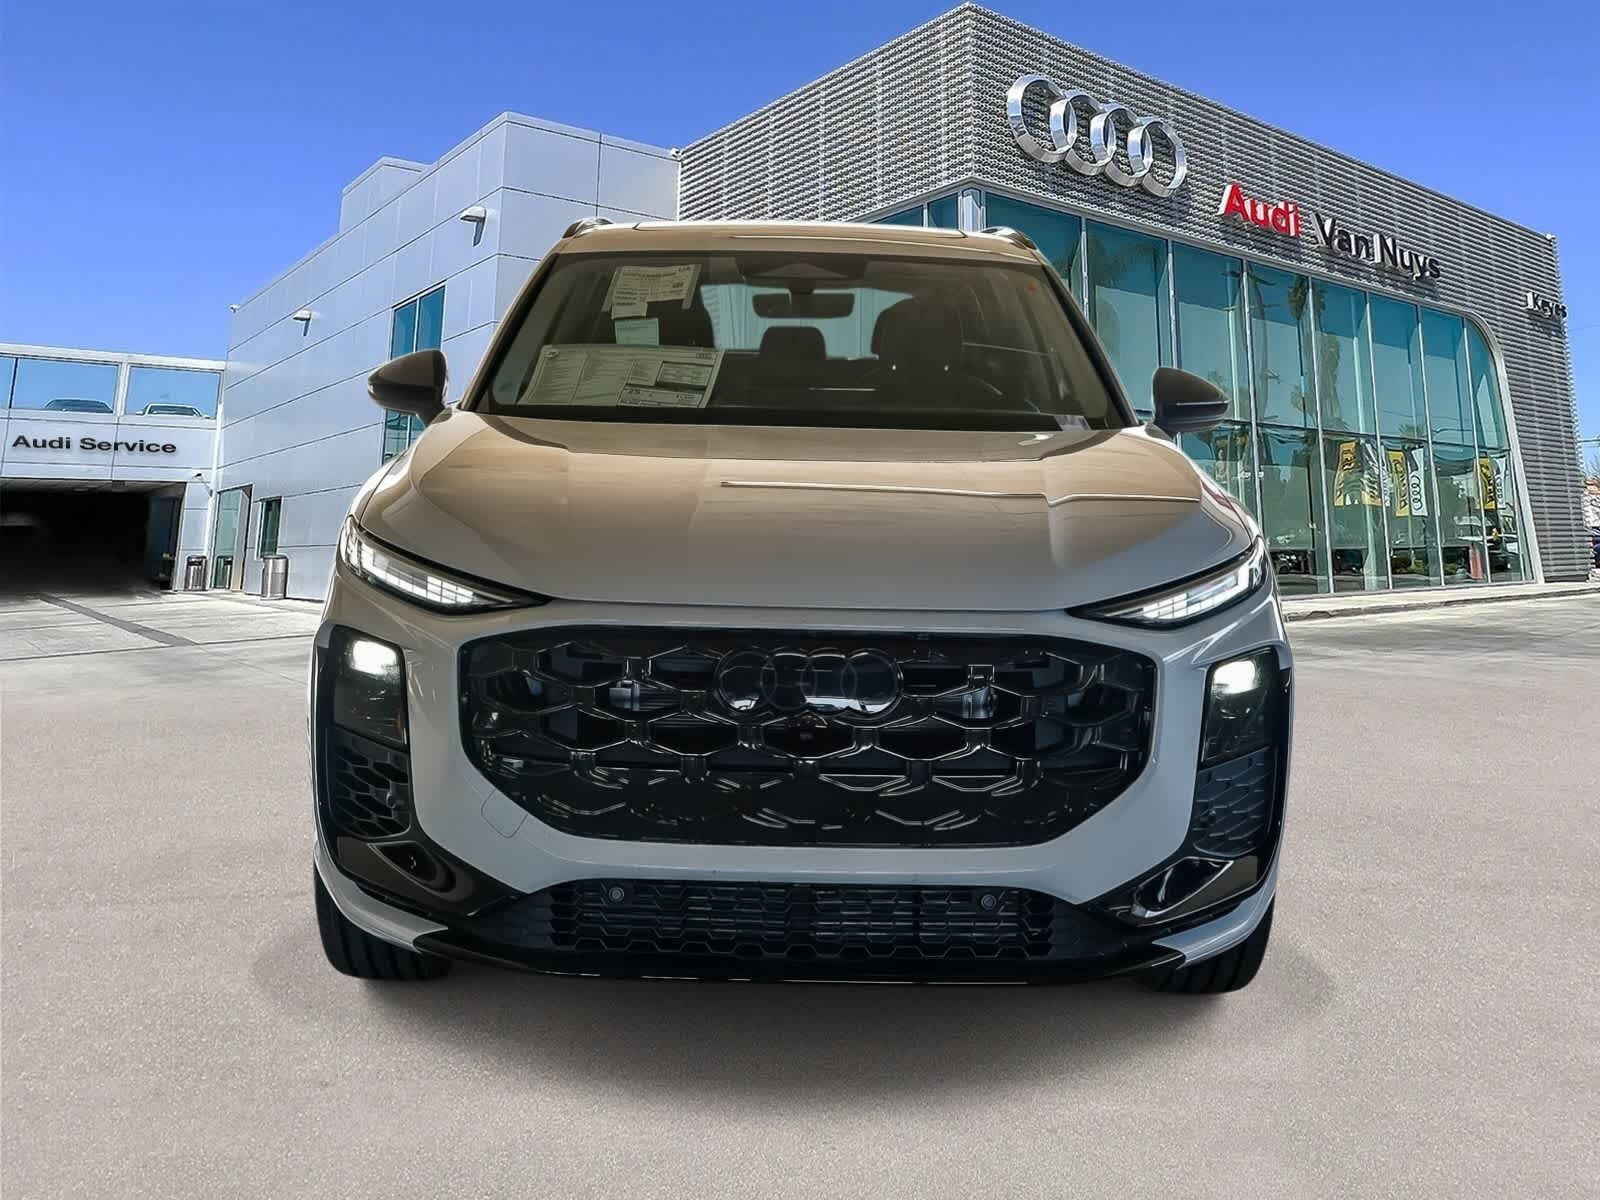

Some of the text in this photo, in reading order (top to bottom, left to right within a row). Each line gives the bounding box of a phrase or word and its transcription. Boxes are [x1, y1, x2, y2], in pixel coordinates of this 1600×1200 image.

[1218, 183, 1441, 280] Audi Van Nuys
[12, 435, 177, 453] Audi Service
